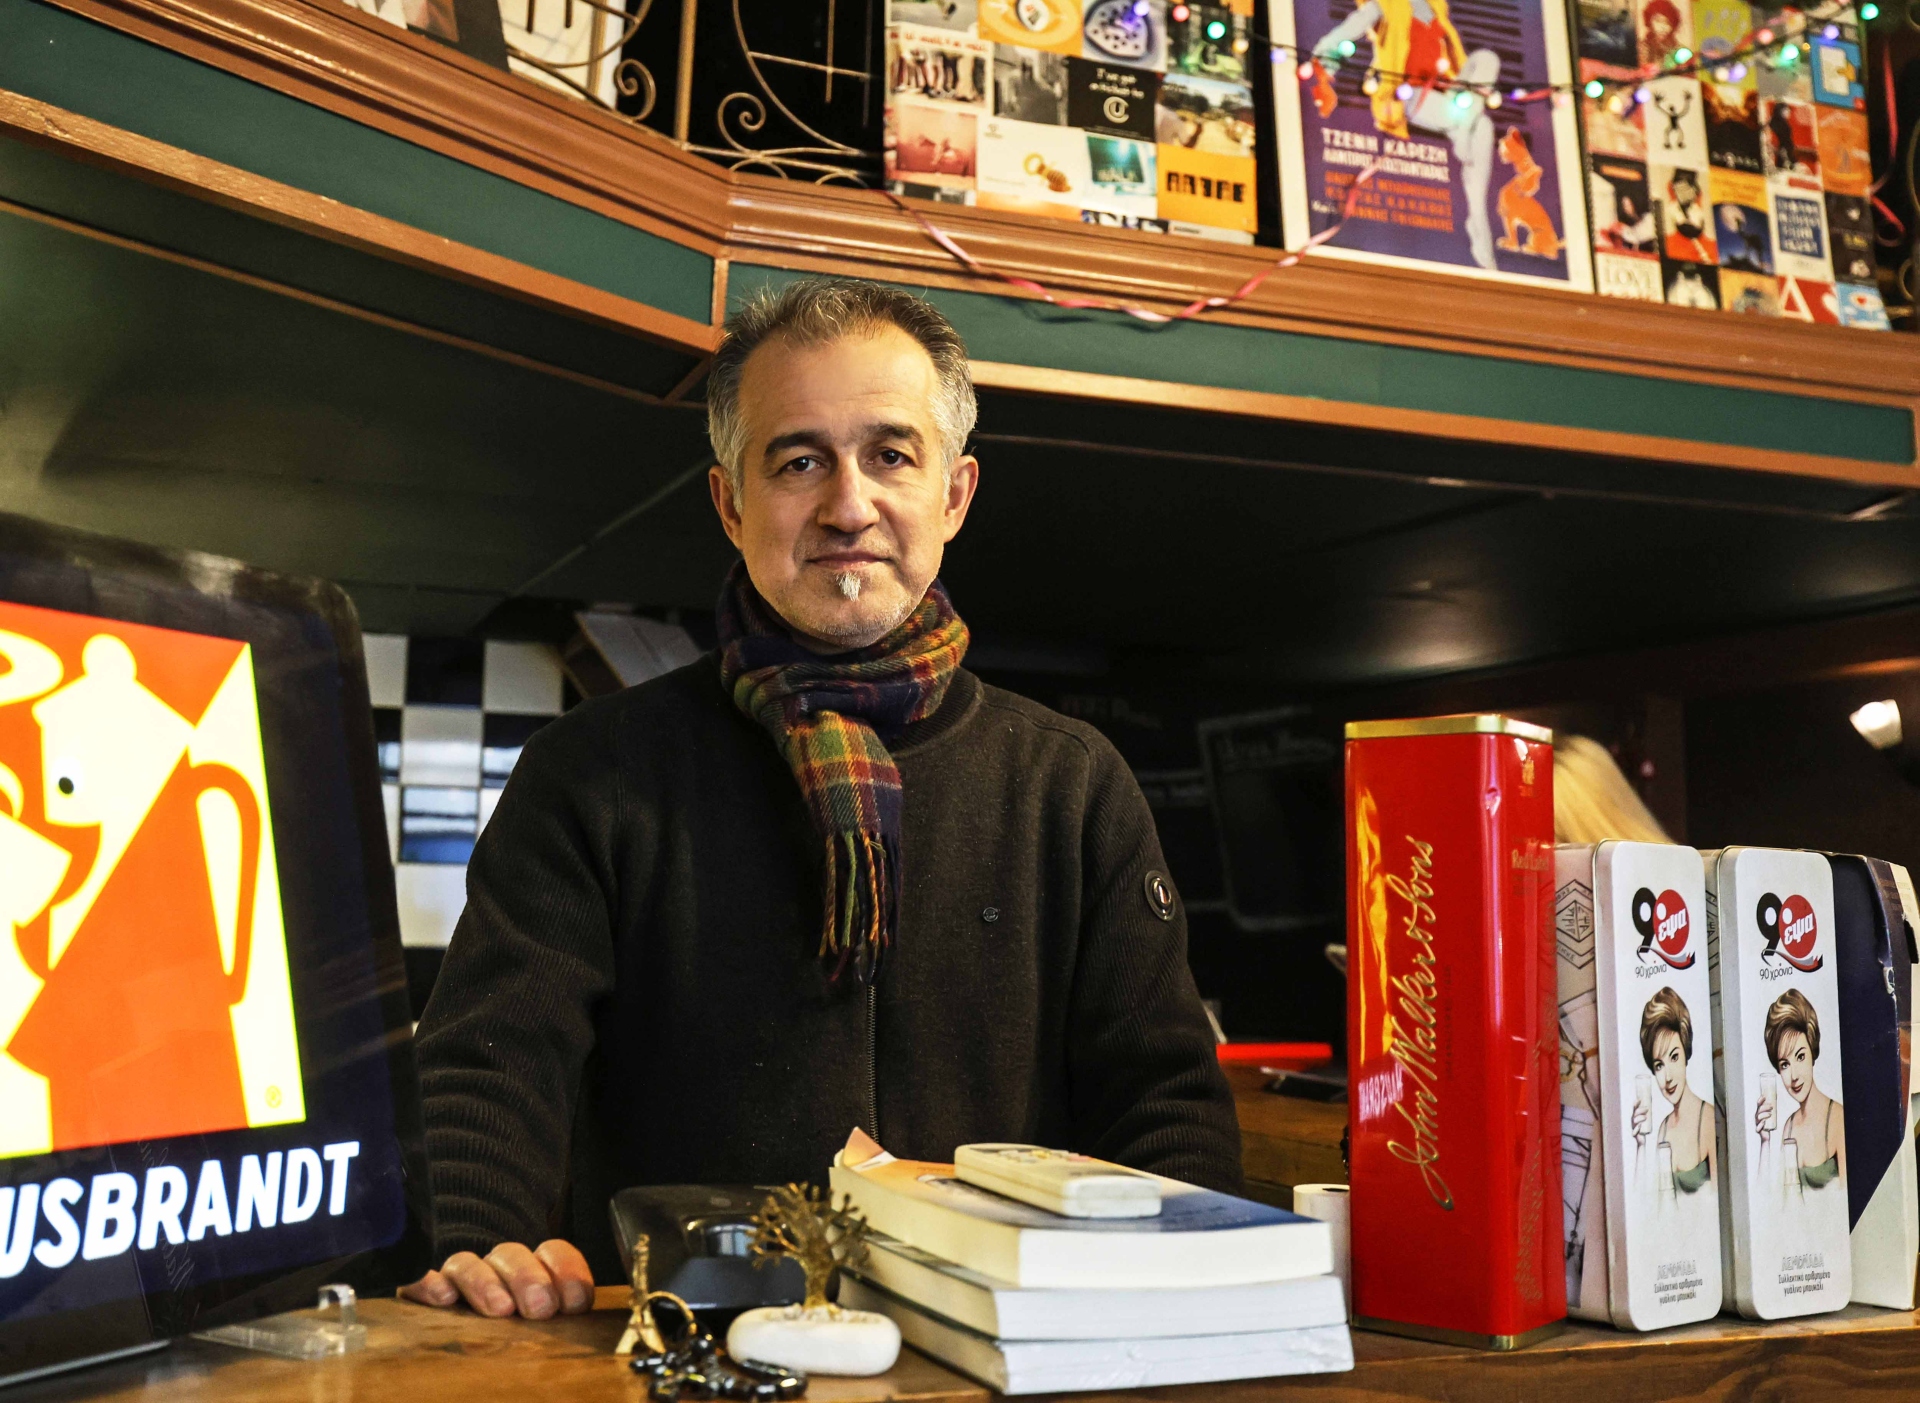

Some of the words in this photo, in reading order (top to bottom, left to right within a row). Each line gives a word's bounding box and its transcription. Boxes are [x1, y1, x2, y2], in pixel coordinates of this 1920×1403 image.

[1635, 965, 1645, 978] 90
[1760, 968, 1770, 980] 90
[0, 1141, 360, 1279] USBRANDT
